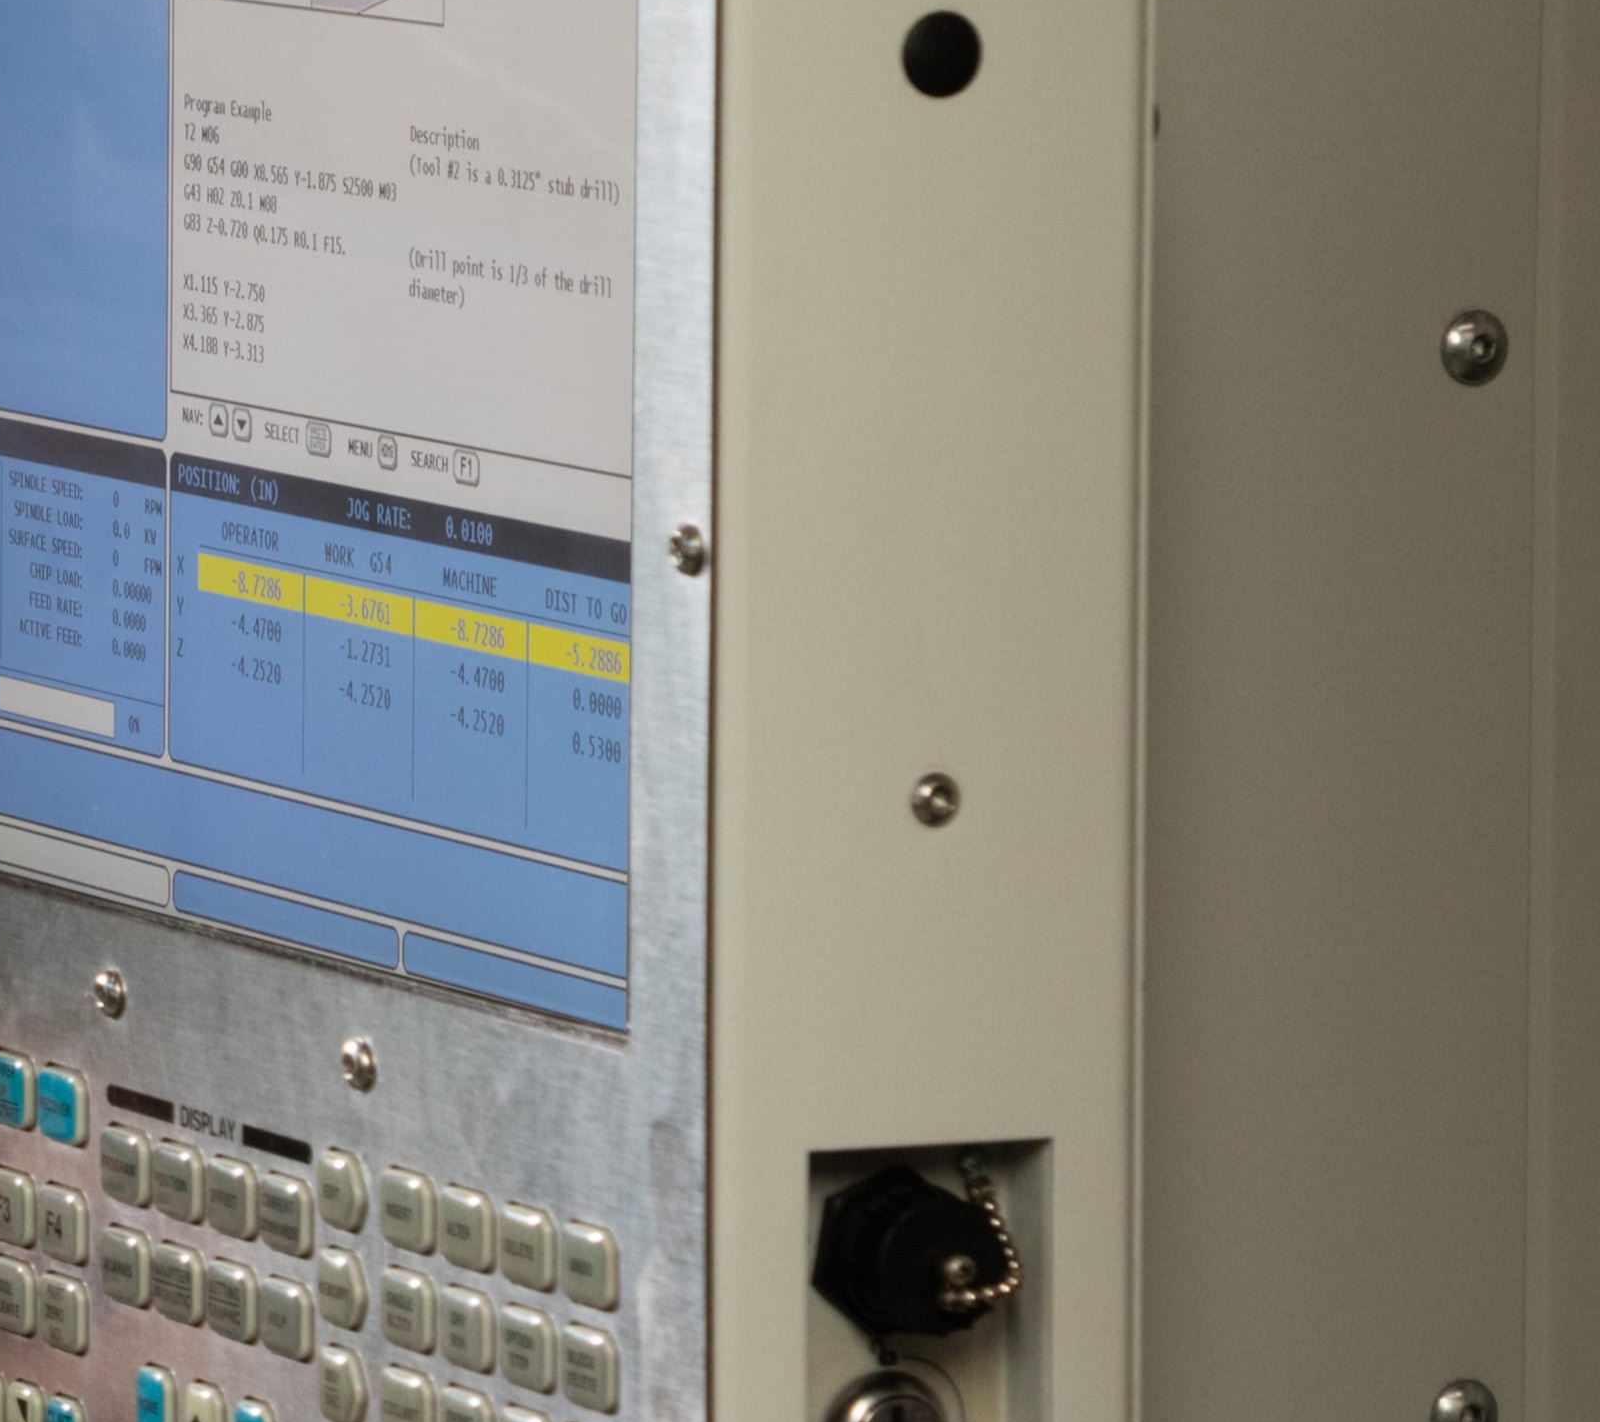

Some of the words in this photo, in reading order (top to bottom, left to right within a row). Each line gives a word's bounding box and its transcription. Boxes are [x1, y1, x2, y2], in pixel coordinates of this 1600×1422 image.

[184, 93, 226, 118] Program
[231, 100, 272, 124] Example
[184, 122, 196, 141] T2
[201, 126, 220, 145] M06
[410, 125, 480, 152] Description
[184, 153, 201, 172] G90
[207, 156, 225, 176] G54
[230, 160, 248, 178] G00
[254, 163, 288, 186] X0.565
[295, 170, 337, 193] Y-1.875
[342, 176, 374, 198] S2500
[379, 182, 397, 202] M03
[184, 183, 201, 202] G43
[207, 186, 224, 206] H02
[409, 154, 441, 178] (Tool
[447, 159, 460, 180] #2
[466, 161, 479, 183] is
[485, 172, 492, 185] a
[497, 167, 541, 191] 0.3125"
[548, 175, 574, 196] stub
[580, 178, 620, 206] drill)
[184, 213, 201, 232] G83
[254, 224, 288, 246] Q0.175
[294, 231, 318, 252] R0.1
[324, 235, 346, 256] F15.
[183, 273, 219, 296] X1.115
[223, 280, 265, 303] Y-2.750
[408, 246, 446, 272] (Drill
[452, 255, 484, 278] point
[491, 260, 503, 281] is
[509, 263, 529, 287] 1/3
[534, 266, 548, 288] of
[554, 270, 574, 292] the
[579, 274, 612, 299] drill
[408, 277, 465, 310] diameter)
[183, 303, 218, 326] X3.365
[223, 310, 265, 334] Y-2.875
[183, 333, 218, 355] X4.188
[223, 340, 264, 363] Y-3.313
[182, 407, 203, 426] NAV:
[265, 423, 299, 444] SELECT
[348, 439, 373, 459] MENU
[410, 451, 449, 474] SEARCH
[460, 457, 472, 478] F1
[8, 470, 46, 494] SPINDLE
[52, 480, 83, 500] SPEED:
[112, 491, 119, 508] 0
[145, 499, 162, 517] RPM
[178, 463, 241, 496] POSITION:
[250, 475, 278, 505] (IN)
[14, 501, 52, 525] SPINDLE
[57, 511, 83, 530] LOAD:
[144, 529, 157, 545] KW
[346, 497, 369, 521] JOG
[377, 503, 411, 529] RATE:
[446, 516, 493, 545] 0.0100
[8, 530, 47, 554] SURFACE
[52, 540, 83, 559] SPEED:
[112, 550, 119, 567] 0
[144, 558, 162, 576] FPM
[221, 521, 279, 552] OPERATOR
[324, 543, 354, 568] WORK
[370, 552, 392, 575] G54
[443, 567, 497, 597] MACHINE
[546, 588, 577, 614] DIST
[588, 598, 601, 619] TO
[611, 603, 627, 625] GO
[29, 563, 52, 582] CHIP
[57, 569, 83, 588] LOAD:
[29, 592, 52, 611] FEED
[57, 599, 82, 618] RATE:
[177, 556, 184, 574] X
[231, 571, 281, 601] -8.7286
[339, 595, 391, 625] -3.6761
[450, 618, 504, 650] -8.7286
[19, 619, 51, 640] ACTIVE
[57, 628, 82, 647] FEED:
[177, 598, 183, 616] Y
[231, 615, 281, 643] -4.4700
[339, 638, 390, 668] -1.2731
[450, 663, 504, 692] -4.4700
[177, 638, 183, 657] Z
[231, 656, 281, 684] -4.2520
[338, 681, 391, 710] -4.2520
[449, 710, 504, 737] -4.2520
[572, 731, 621, 764] 0.5300
[180, 1104, 235, 1141] DISPLAY
[46, 1212, 63, 1240] F4
